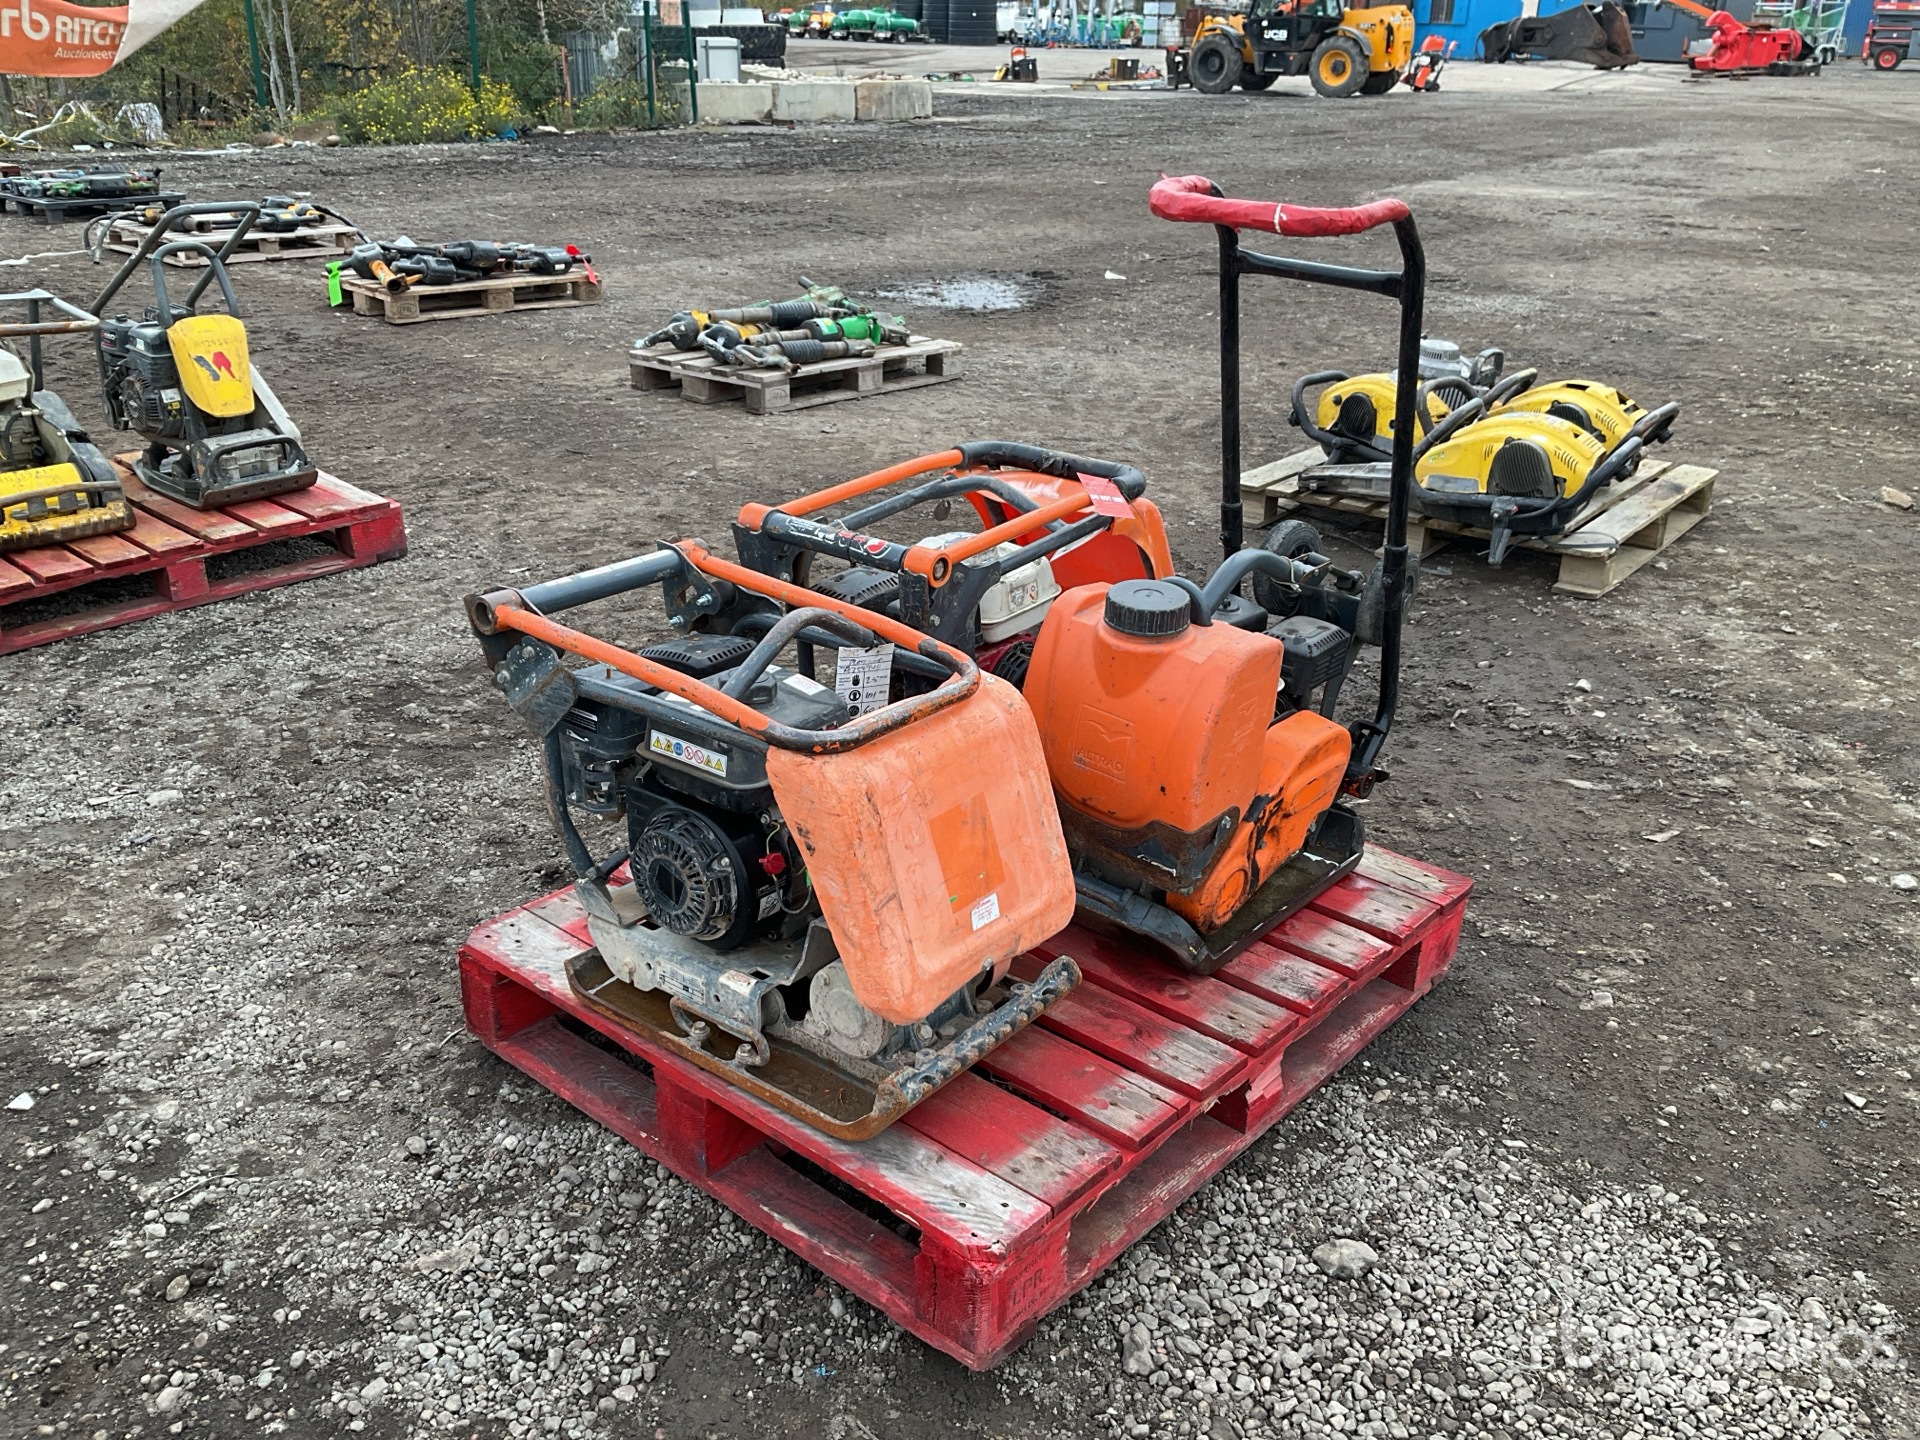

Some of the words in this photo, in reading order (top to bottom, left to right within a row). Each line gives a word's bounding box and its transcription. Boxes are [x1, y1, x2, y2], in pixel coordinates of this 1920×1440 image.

[1263, 29, 1288, 38] JCB
[1076, 747, 1122, 774] ALTRAD
[1010, 1268, 1043, 1306] LPR
